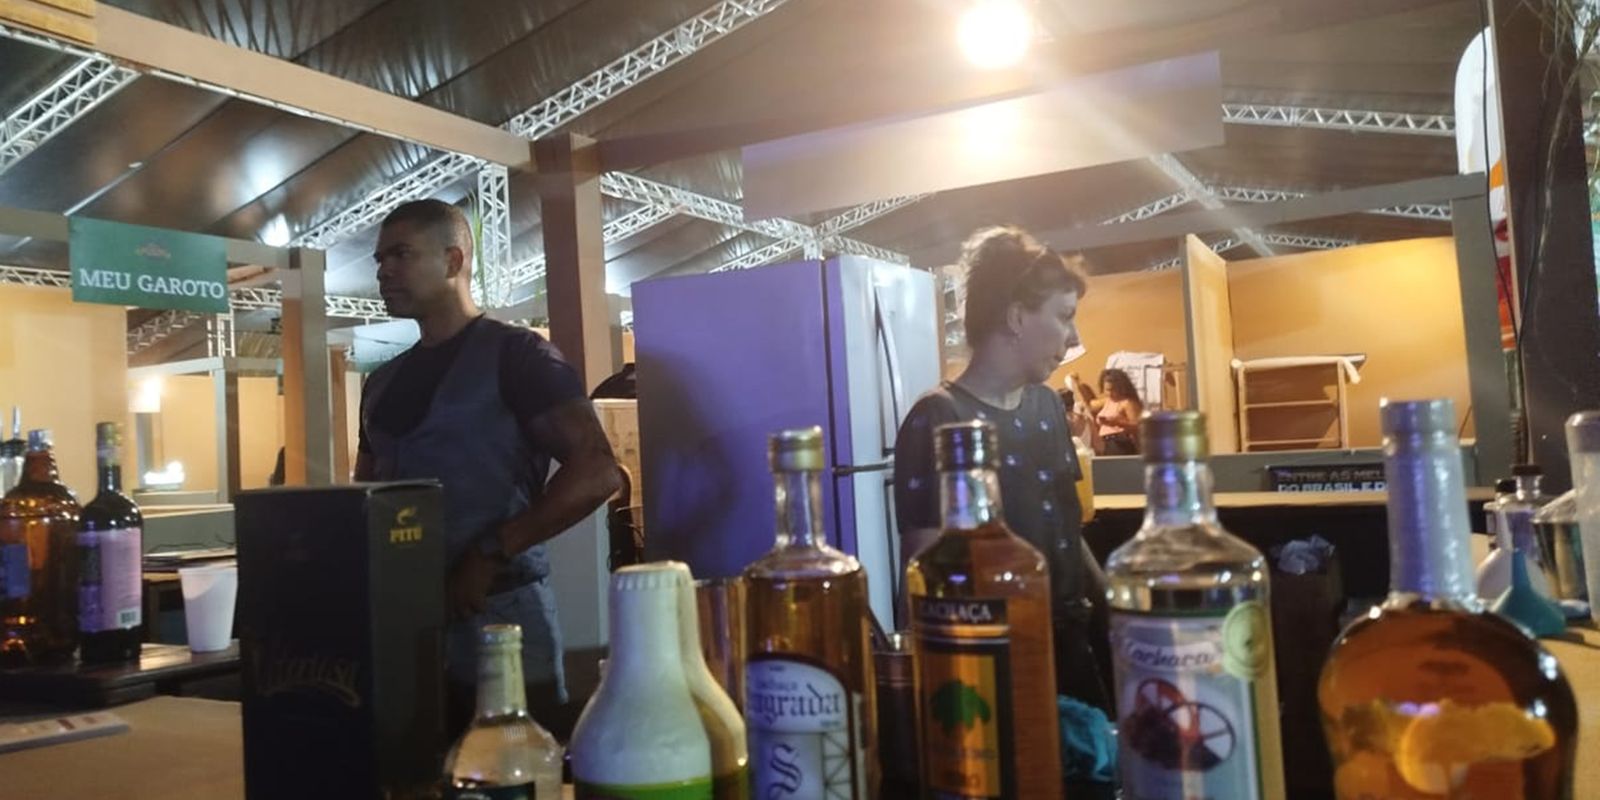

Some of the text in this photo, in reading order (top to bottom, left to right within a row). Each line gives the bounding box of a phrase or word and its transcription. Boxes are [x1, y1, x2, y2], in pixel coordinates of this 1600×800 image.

[79, 268, 225, 299] MEU GAROTO
[1302, 482, 1359, 493] BRASIL
[748, 683, 842, 726] agrada
